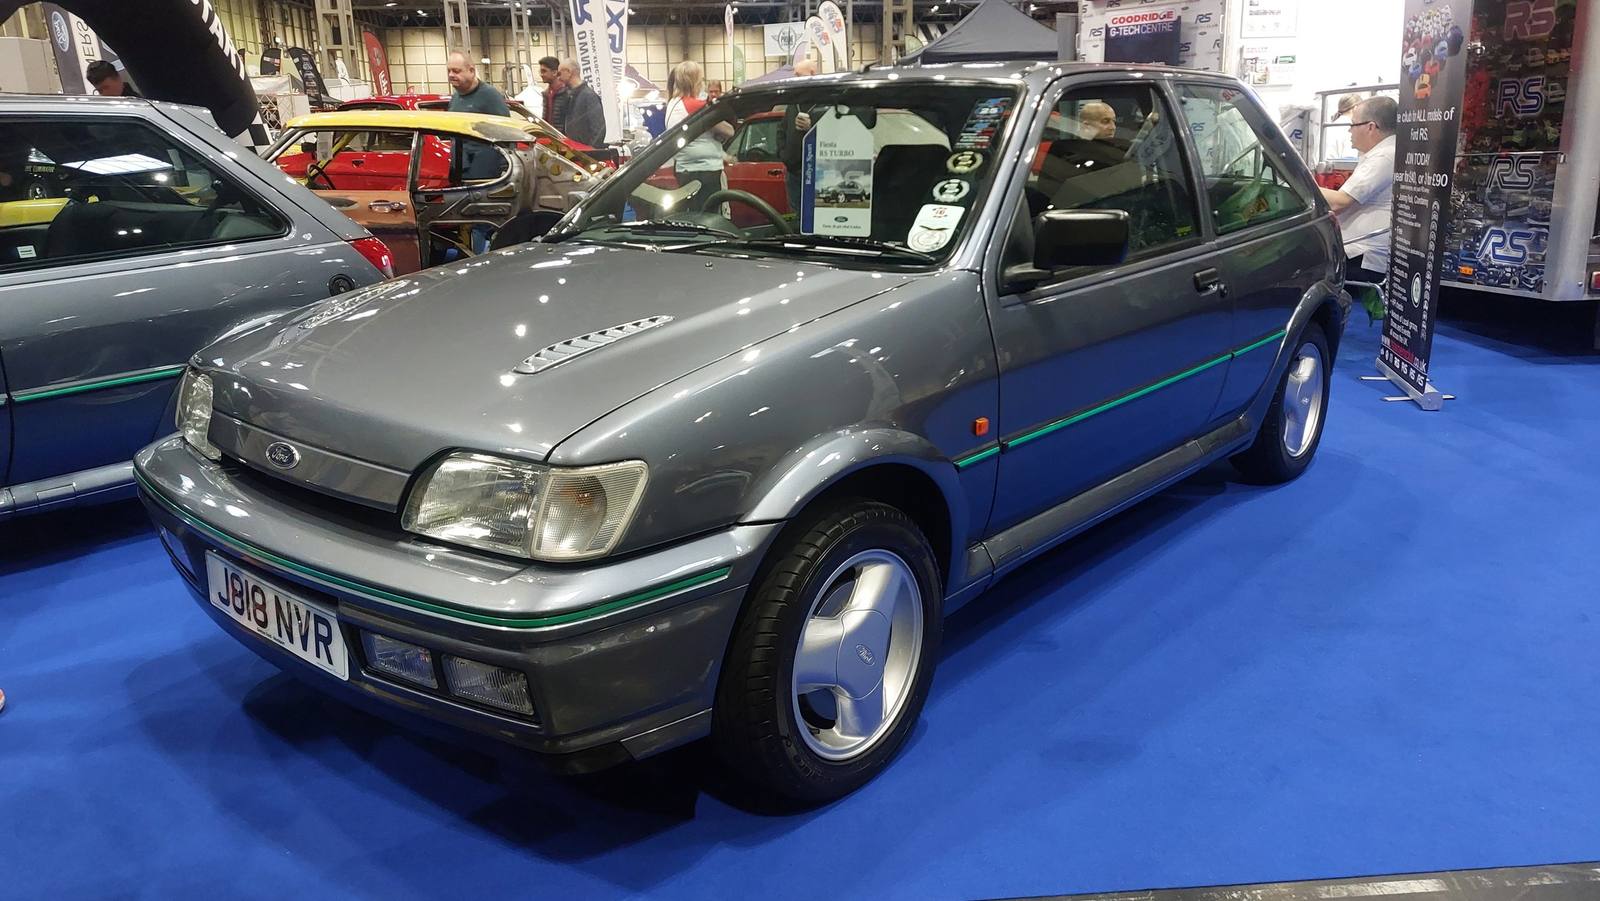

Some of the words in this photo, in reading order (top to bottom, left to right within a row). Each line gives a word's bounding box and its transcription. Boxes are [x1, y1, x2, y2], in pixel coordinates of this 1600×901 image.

[1112, 11, 1174, 25] GOODRIDGE
[1195, 12, 1213, 24] RS
[1504, 0, 1557, 41] RS
[1088, 27, 1104, 37] RS
[1496, 76, 1546, 119] RS
[1444, 107, 1455, 121] of
[1414, 153, 1431, 166] TODAY
[1486, 154, 1542, 191] RS
[1432, 173, 1448, 187] £90
[1475, 227, 1536, 267] RS
[218, 567, 268, 629] J818
[274, 595, 333, 666] NVR
